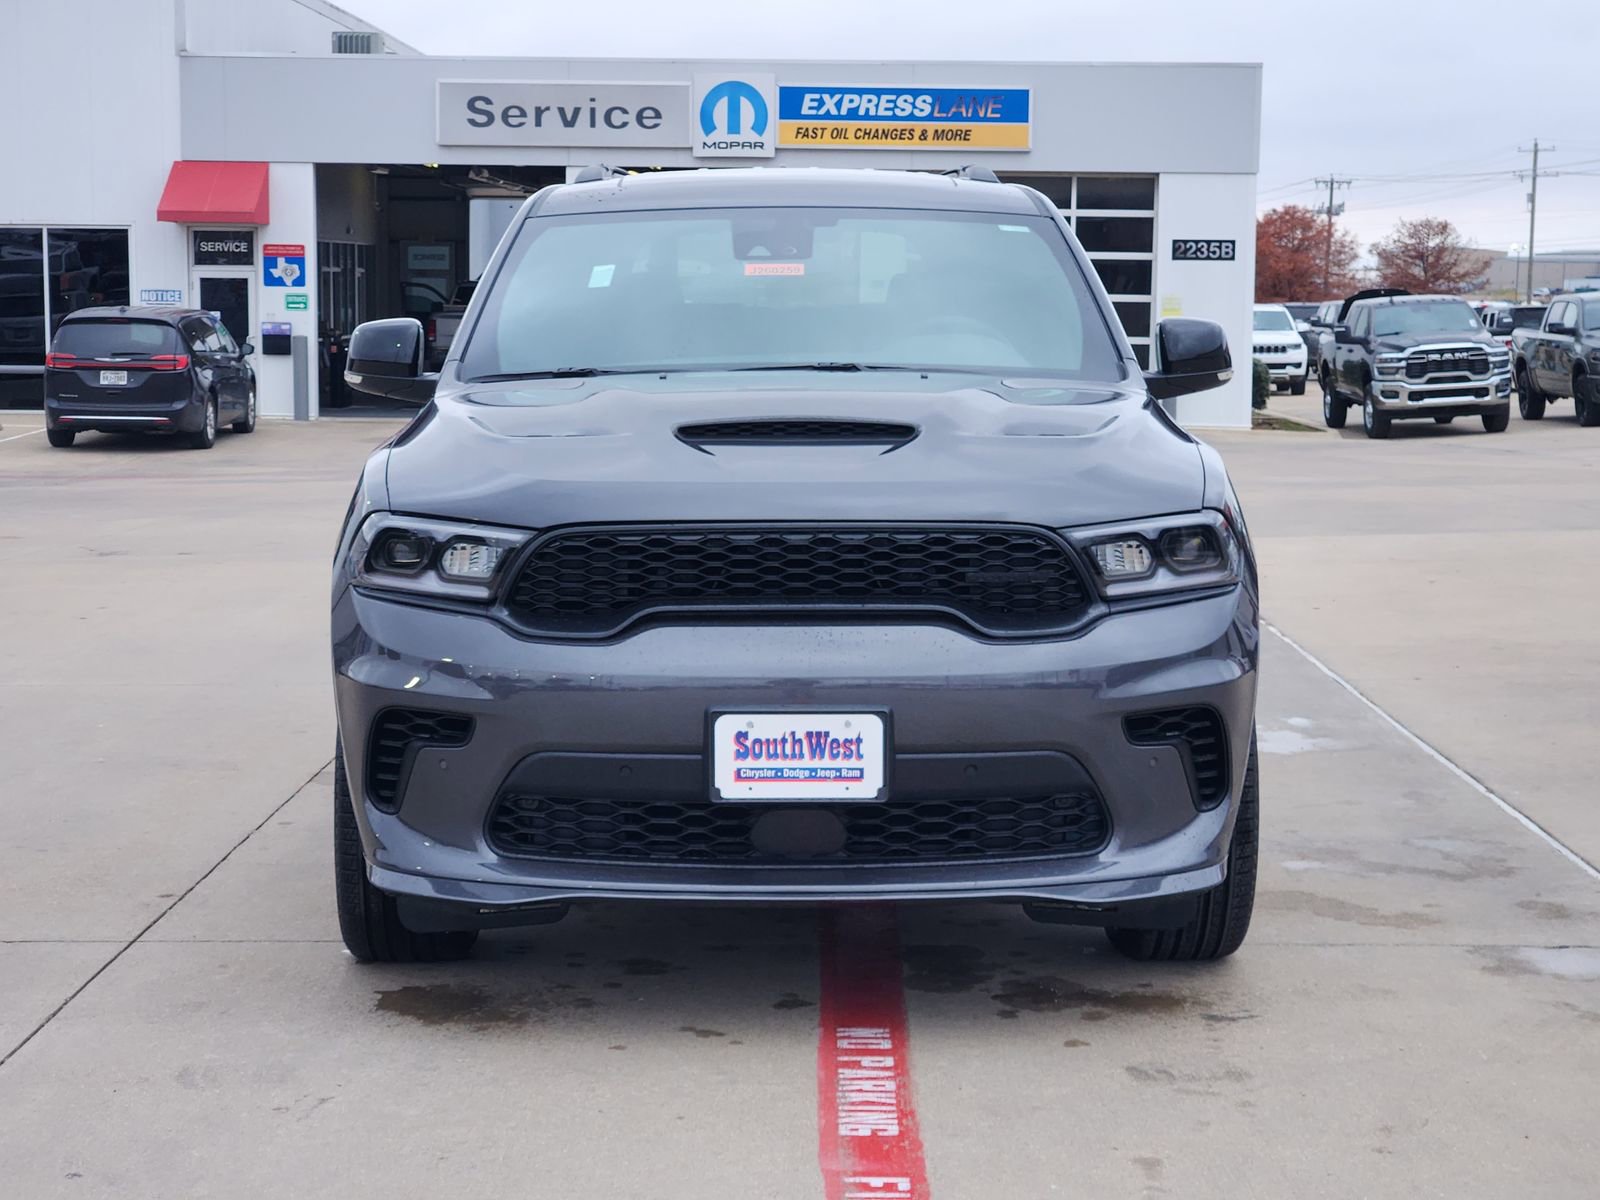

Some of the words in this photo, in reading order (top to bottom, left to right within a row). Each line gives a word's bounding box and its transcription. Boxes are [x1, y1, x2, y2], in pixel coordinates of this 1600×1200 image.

[466, 95, 663, 129] Service
[795, 127, 825, 140] FAST
[831, 128, 849, 140] OIL
[854, 128, 914, 141] CHANGES
[919, 129, 928, 141] &
[933, 129, 972, 141] MORE
[702, 142, 765, 150] MOPAR
[200, 241, 248, 252] SERVICE
[1175, 241, 1233, 258] 2235B
[141, 290, 181, 301] NOTICE
[1428, 352, 1468, 361] RAM
[734, 731, 864, 761] SouthWest
[740, 768, 776, 778] Chrysler
[783, 768, 810, 779] Dodge
[816, 768, 836, 778] Jeep
[841, 768, 861, 778] Ram
[836, 1028, 892, 1049] NO
[836, 1056, 900, 1136] PARKING
